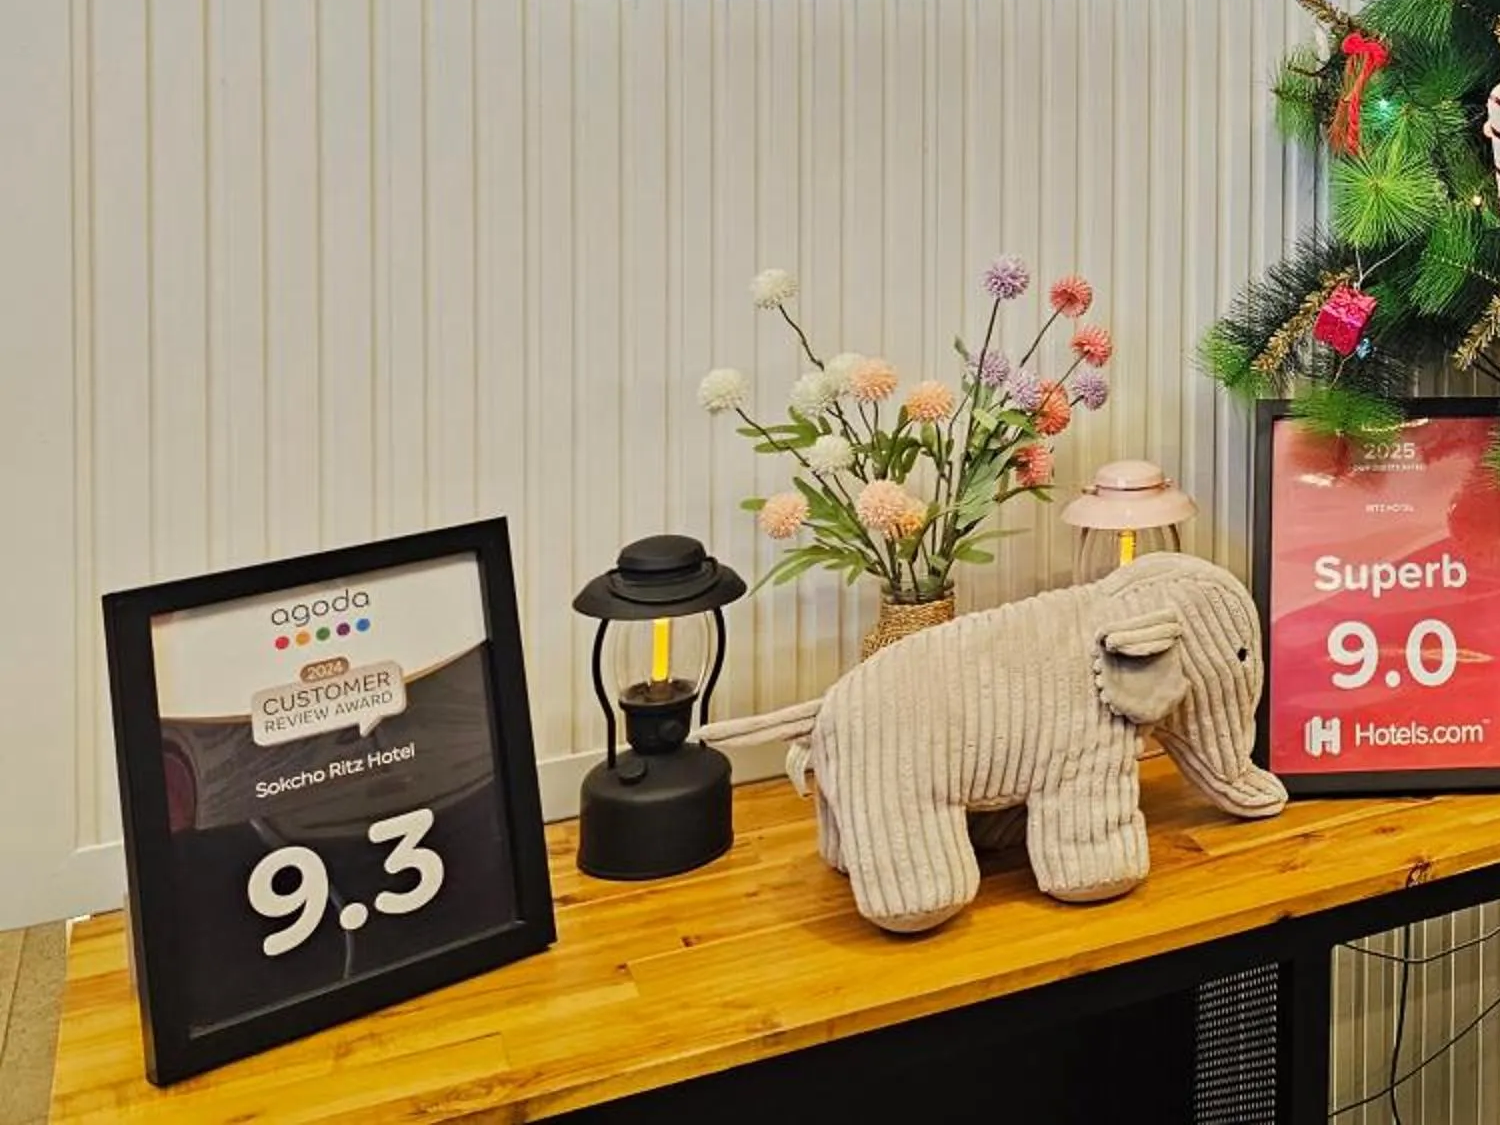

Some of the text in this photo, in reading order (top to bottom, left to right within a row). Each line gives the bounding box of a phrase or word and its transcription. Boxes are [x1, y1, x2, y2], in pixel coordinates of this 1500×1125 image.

[1363, 442, 1416, 460] 2025
[1314, 553, 1468, 599] Superb
[271, 588, 370, 627] agoda
[306, 659, 345, 681] 2024
[1327, 618, 1458, 689] 9.0
[263, 670, 391, 716] CUSTOMER
[264, 690, 393, 735] REVIEW AWARD
[1355, 720, 1484, 748] Hotels.com
[255, 742, 416, 799] Sokcho Ritz Hotel
[247, 807, 446, 957] 9.3
